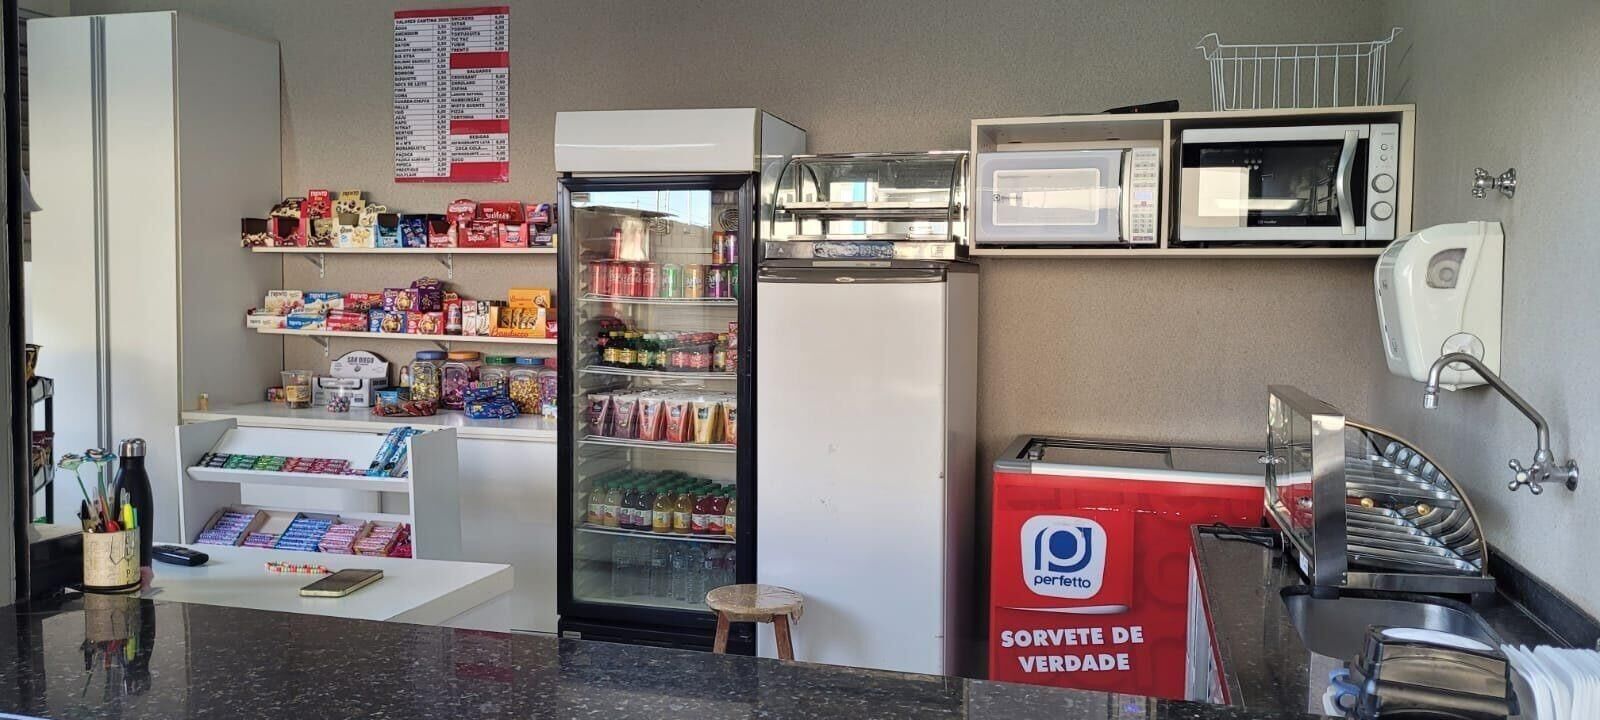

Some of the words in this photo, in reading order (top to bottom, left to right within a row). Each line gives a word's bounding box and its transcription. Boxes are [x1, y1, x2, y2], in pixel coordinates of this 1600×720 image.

[1033, 574, 1091, 589] perfetto
[1000, 627, 1104, 648] SORVETE
[1112, 626, 1144, 644] DE
[1017, 653, 1130, 673] VERDADE
